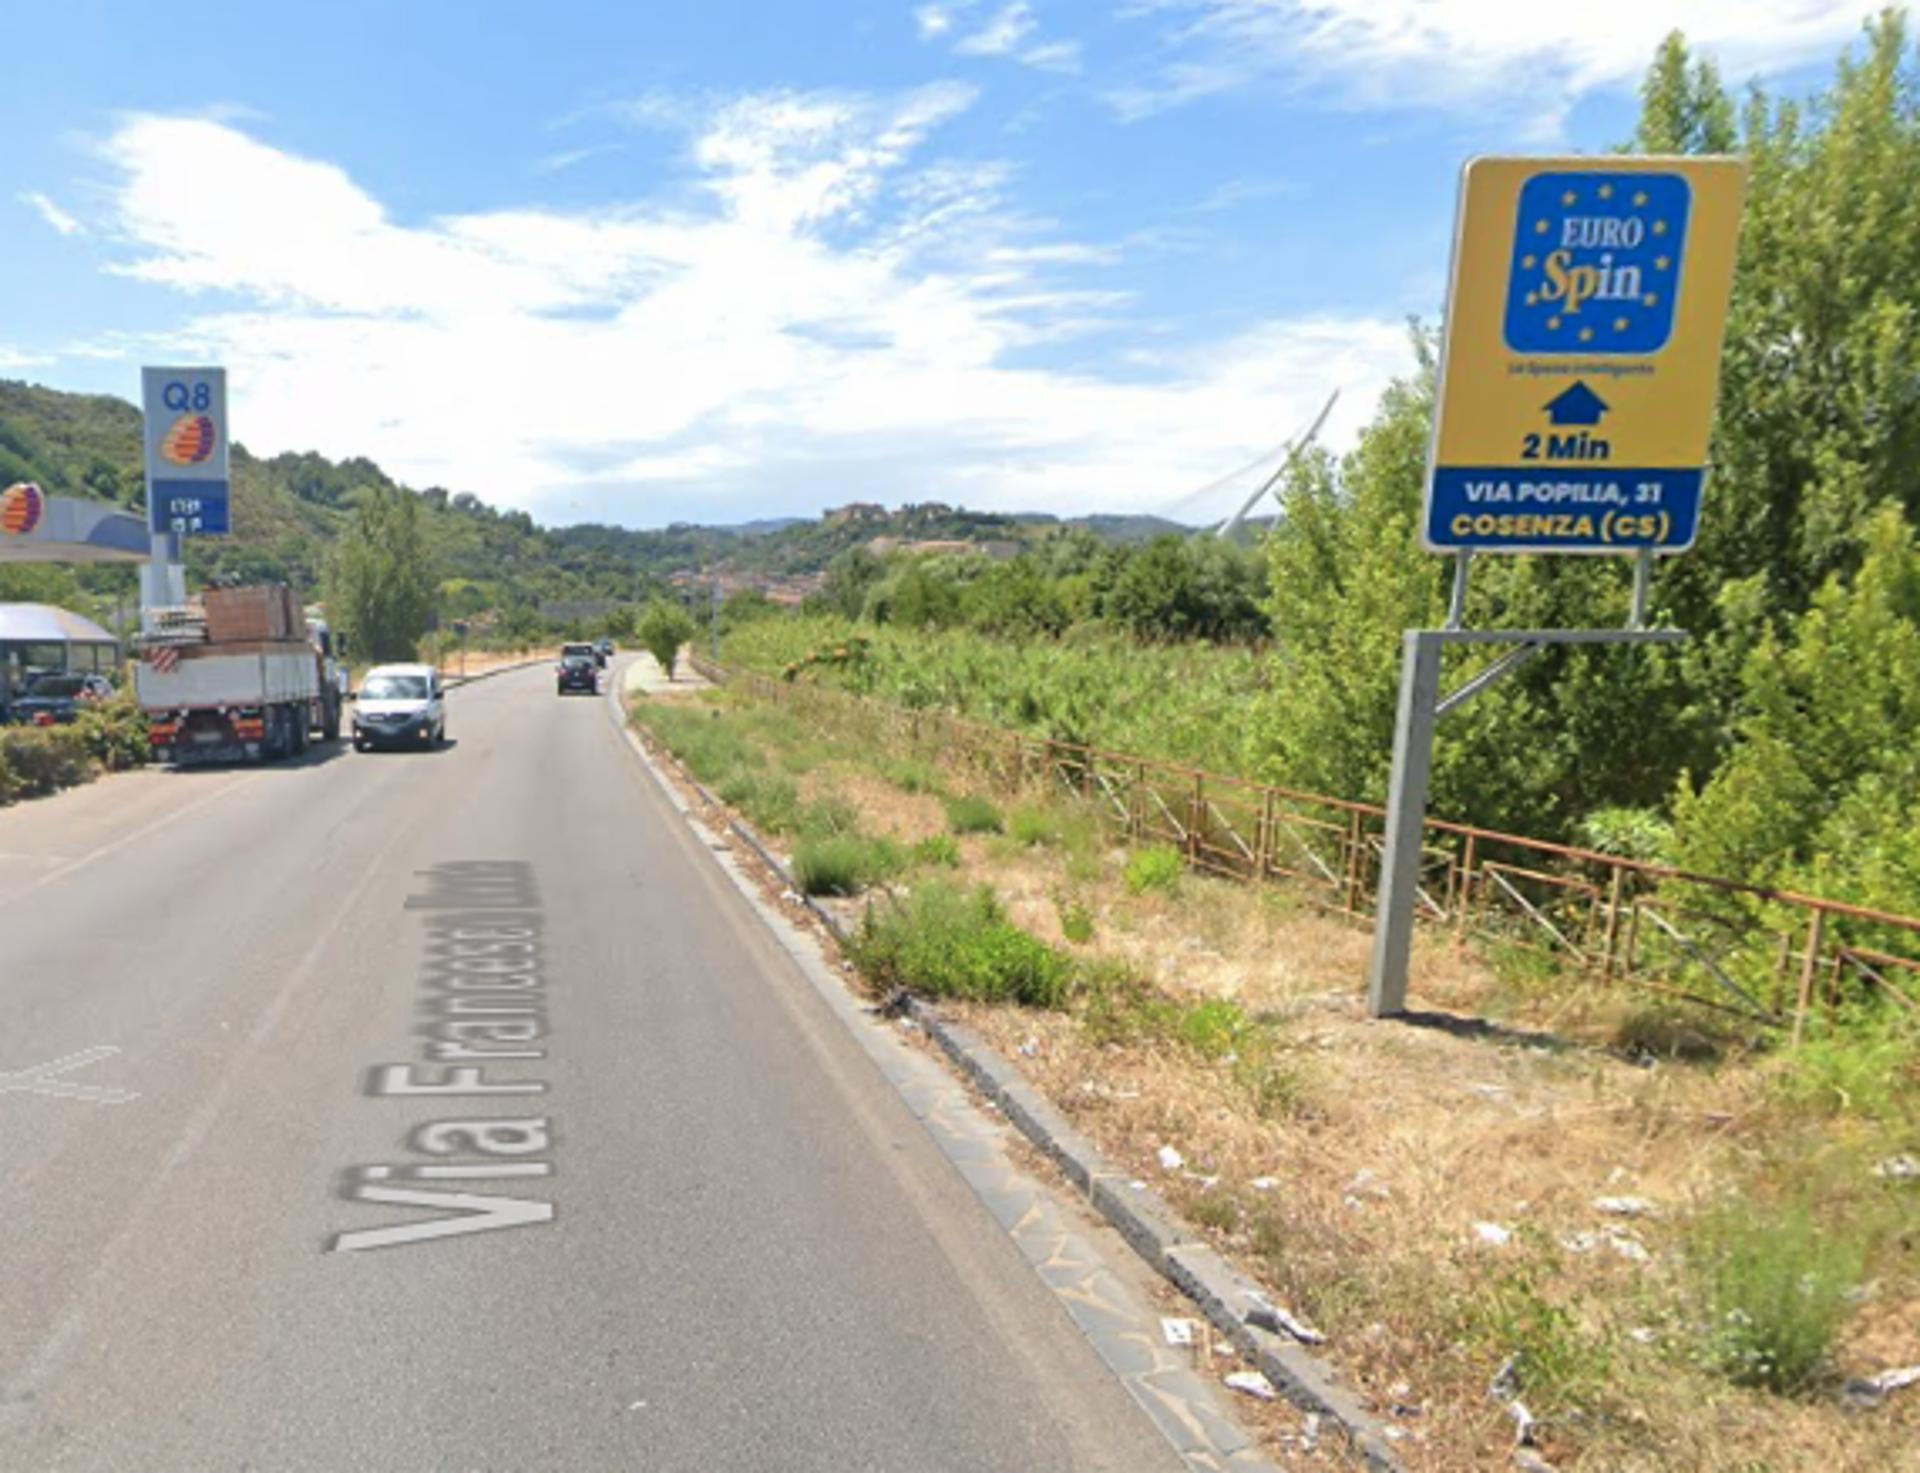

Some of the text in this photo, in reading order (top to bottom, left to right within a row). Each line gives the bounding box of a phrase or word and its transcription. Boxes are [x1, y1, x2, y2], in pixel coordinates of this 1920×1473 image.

[1560, 216, 1645, 249] EURO
[1540, 250, 1642, 314] Spin
[163, 382, 210, 413] Q8
[1521, 432, 1609, 460] 2 Min
[1464, 482, 1663, 507] VIA POPILIA, 31
[1451, 510, 1670, 543] COSENZA (CS)
